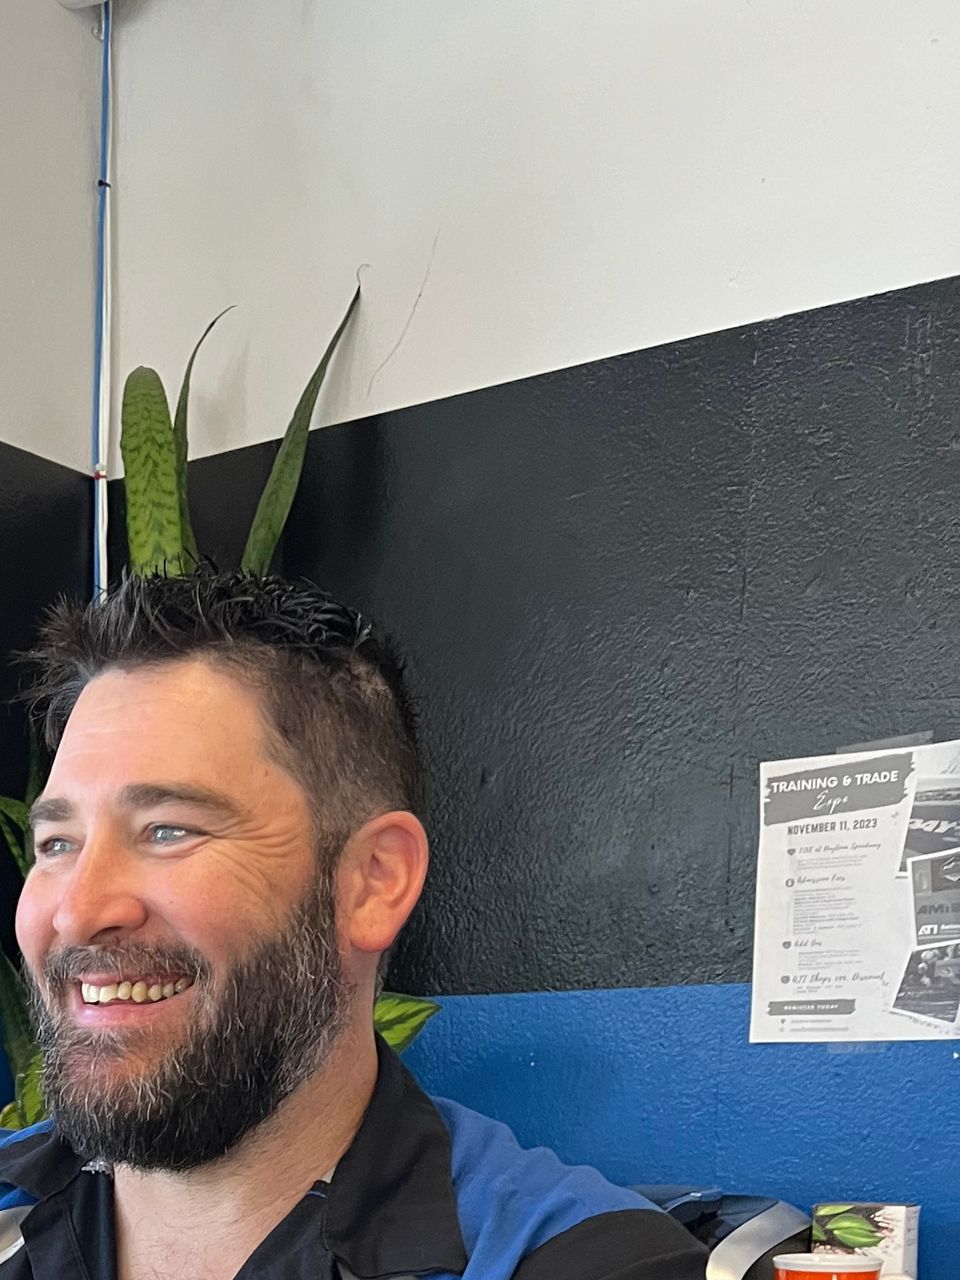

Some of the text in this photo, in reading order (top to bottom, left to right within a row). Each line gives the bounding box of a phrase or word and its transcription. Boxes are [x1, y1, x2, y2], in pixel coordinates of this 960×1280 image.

[771, 770, 899, 793] TRAINING & TRADE
[787, 818, 878, 835] NOVEMBER 11, 2023
